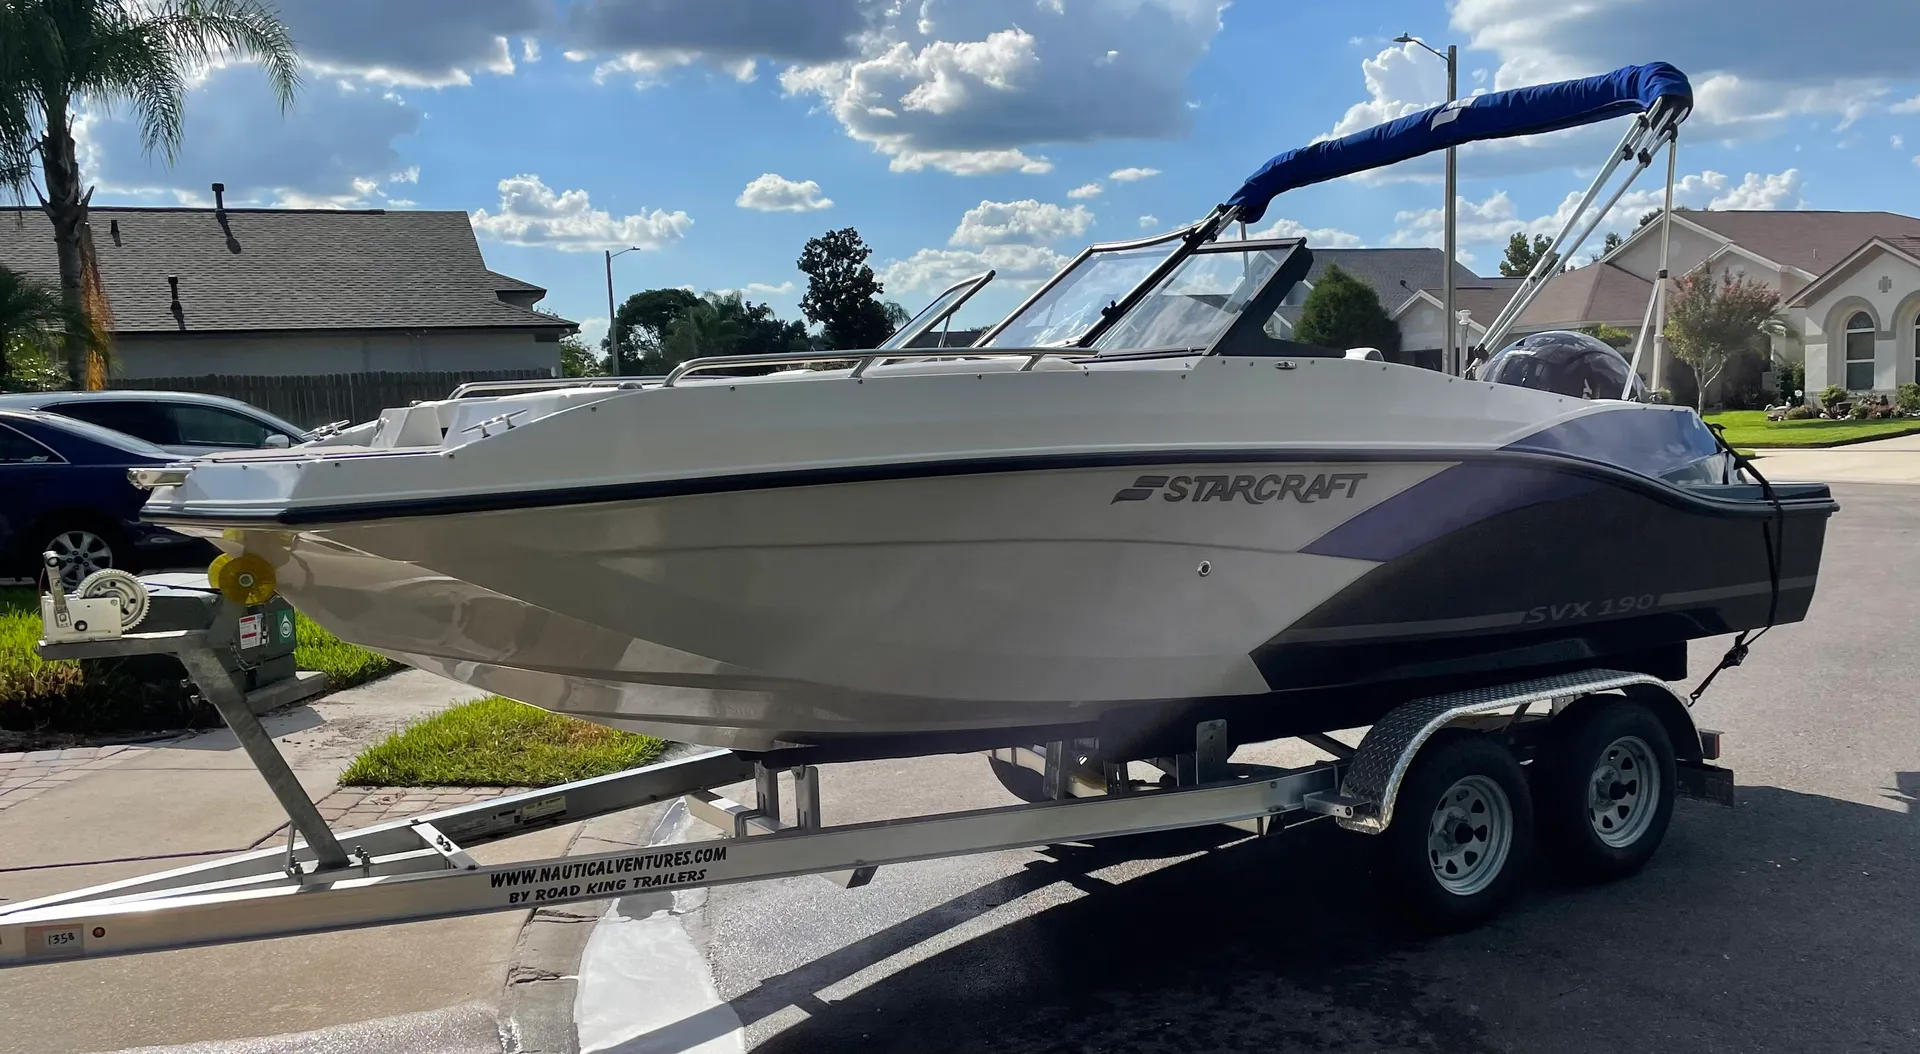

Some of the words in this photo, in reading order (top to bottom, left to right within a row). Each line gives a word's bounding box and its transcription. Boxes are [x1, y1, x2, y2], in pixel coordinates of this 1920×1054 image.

[1163, 473, 1368, 505] STARCRAFT
[1523, 601, 1592, 624] SVX
[1597, 594, 1655, 616] 190
[490, 846, 727, 888] WWW.NAUTICALVENTURES.COM
[509, 890, 531, 903] BY
[535, 885, 581, 901] ROAD
[586, 879, 627, 895] KING
[632, 868, 707, 889] TRAILERS
[48, 932, 75, 945] 1358
